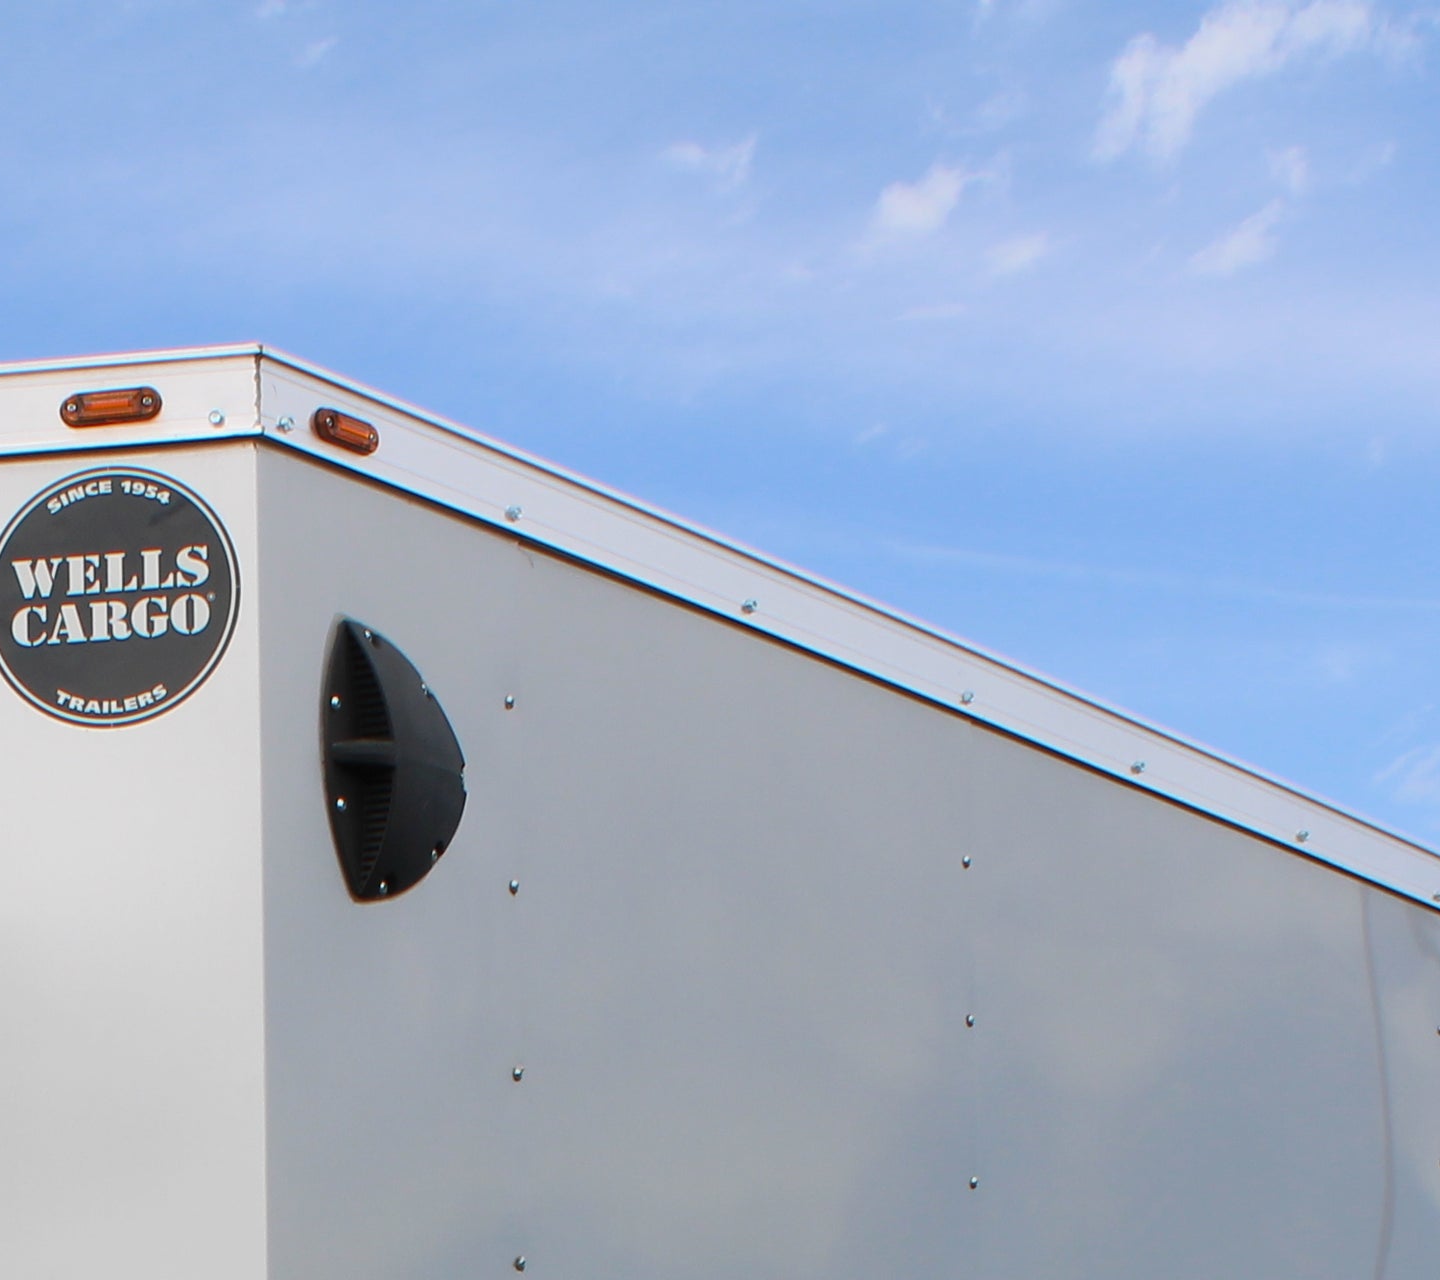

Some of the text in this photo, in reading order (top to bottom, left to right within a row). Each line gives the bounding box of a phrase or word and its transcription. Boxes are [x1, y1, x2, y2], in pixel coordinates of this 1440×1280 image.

[46, 480, 171, 515] SINCE 1954
[11, 544, 210, 600] WELLS
[11, 593, 211, 648] CARGO
[56, 684, 168, 714] TRAILERS
